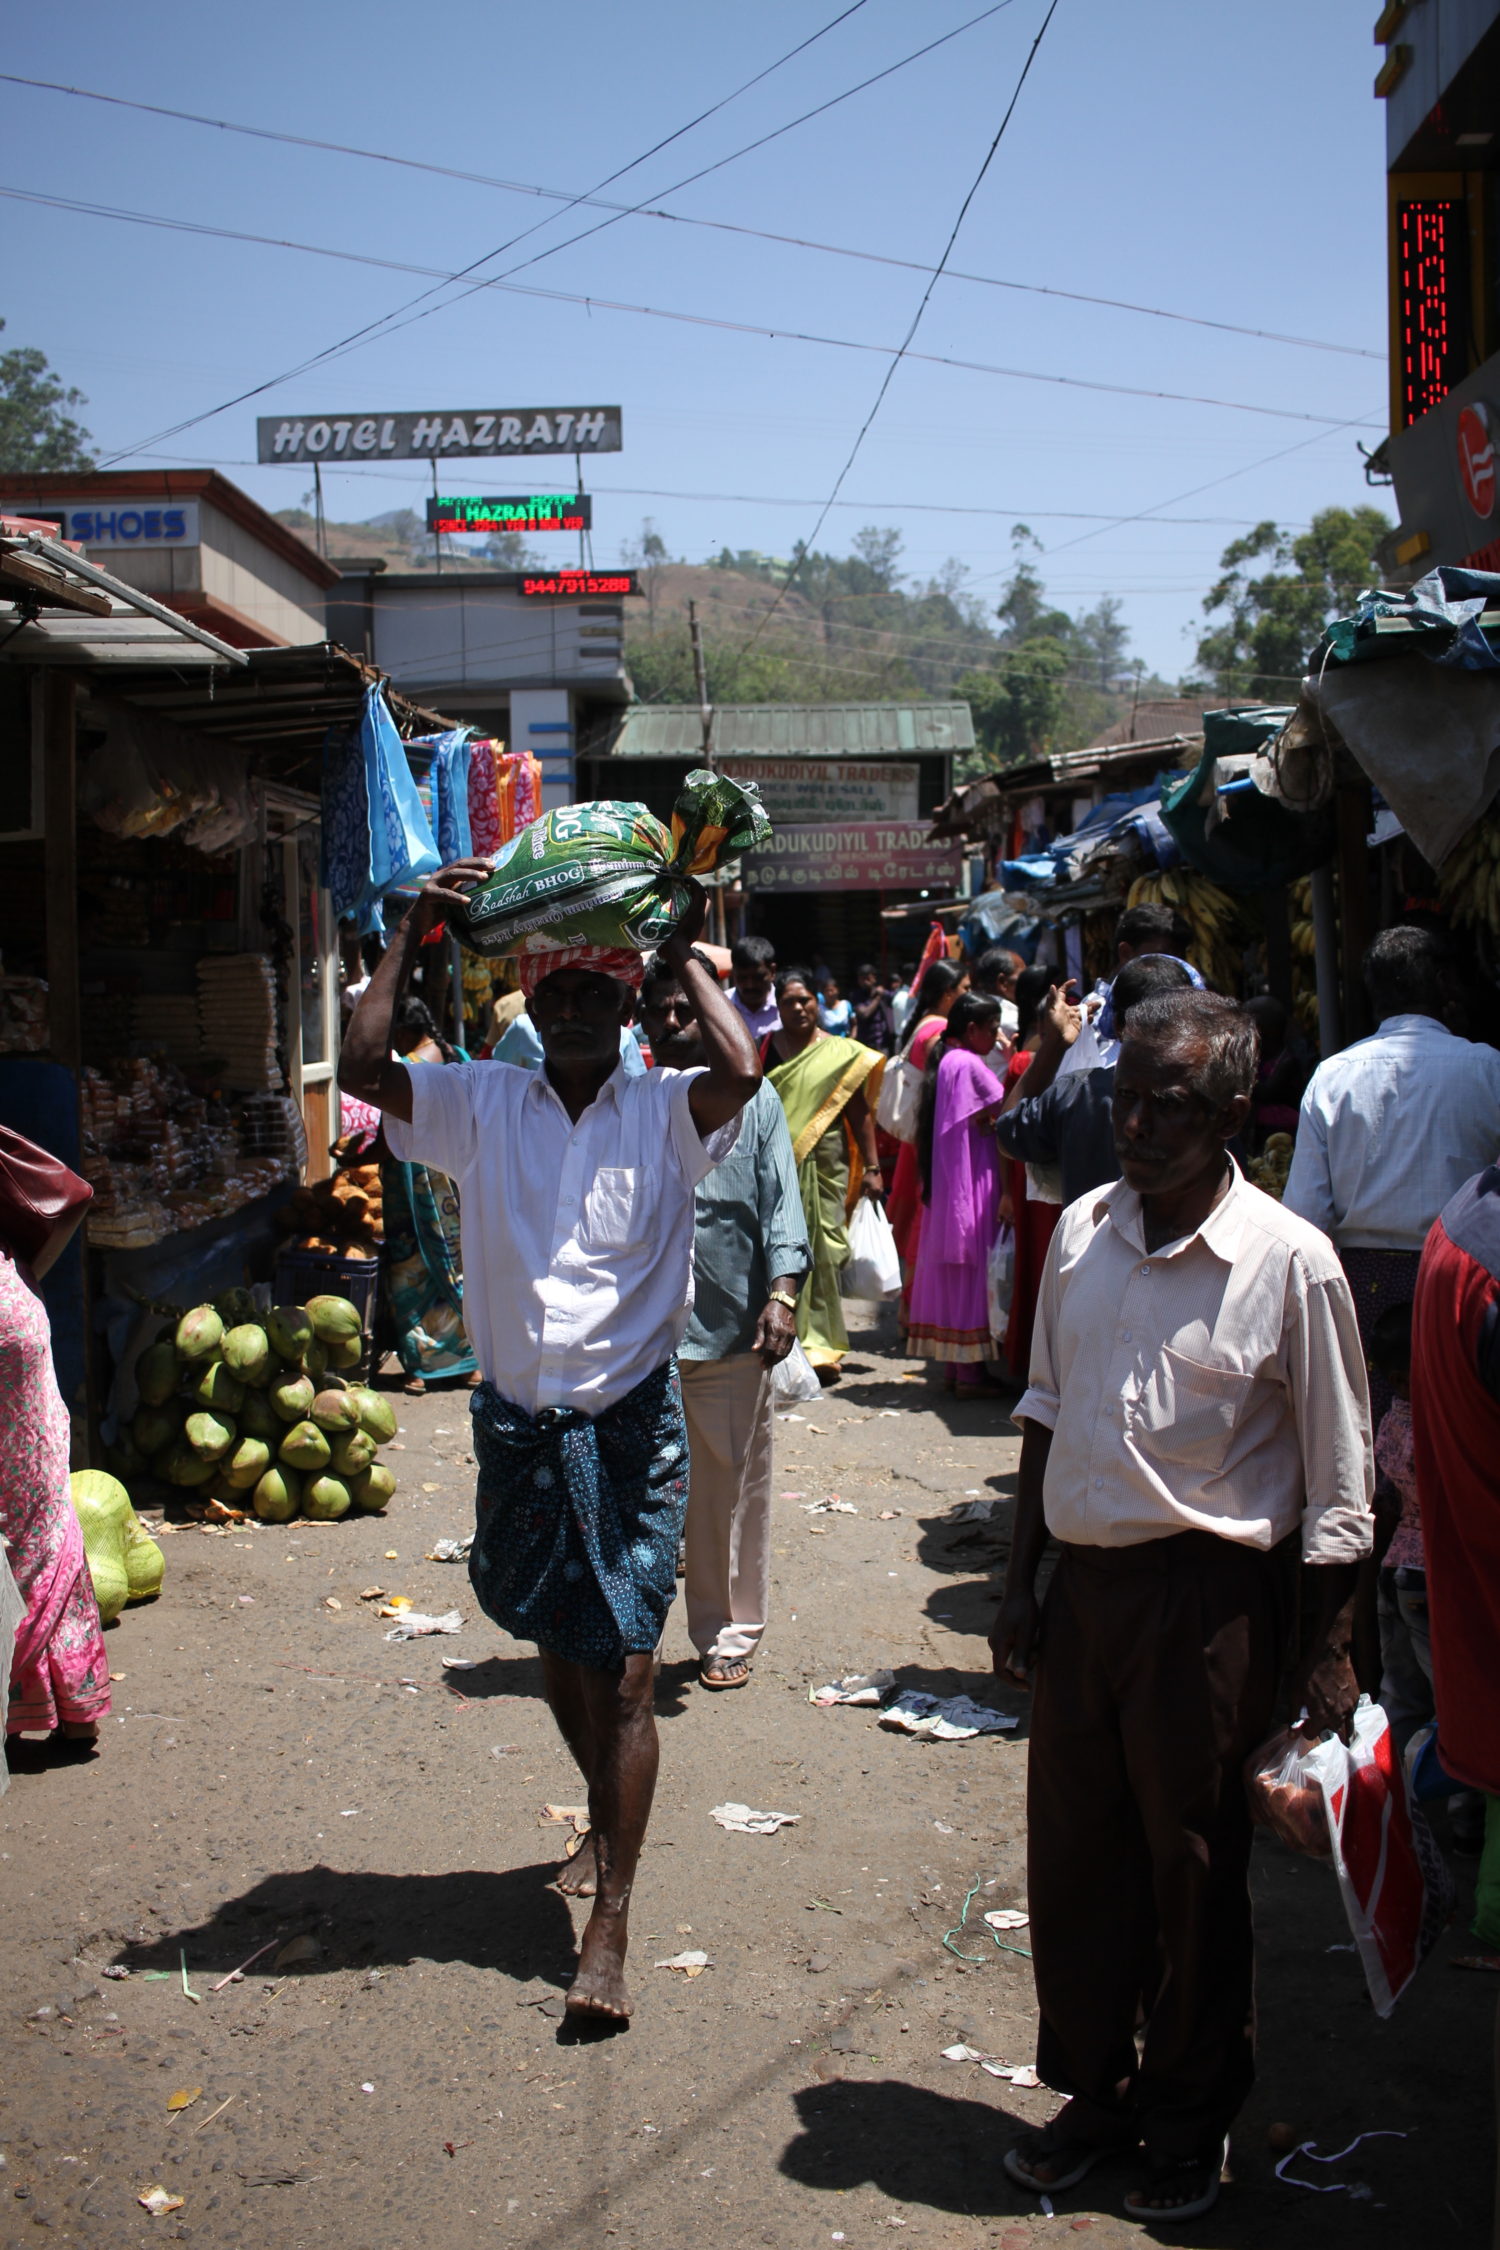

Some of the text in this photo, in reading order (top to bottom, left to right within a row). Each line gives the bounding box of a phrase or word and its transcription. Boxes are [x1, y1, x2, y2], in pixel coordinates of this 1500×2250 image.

[274, 411, 605, 453] HOTEL HAZRATH
[71, 510, 186, 541] SHOES
[723, 762, 916, 783] NADUKUDIYIL TRADERS
[750, 831, 868, 854] NADUKUDIYIL
[470, 867, 582, 917] Badshah BHOG
[513, 907, 564, 936] Quality
[481, 931, 514, 946] Rice
